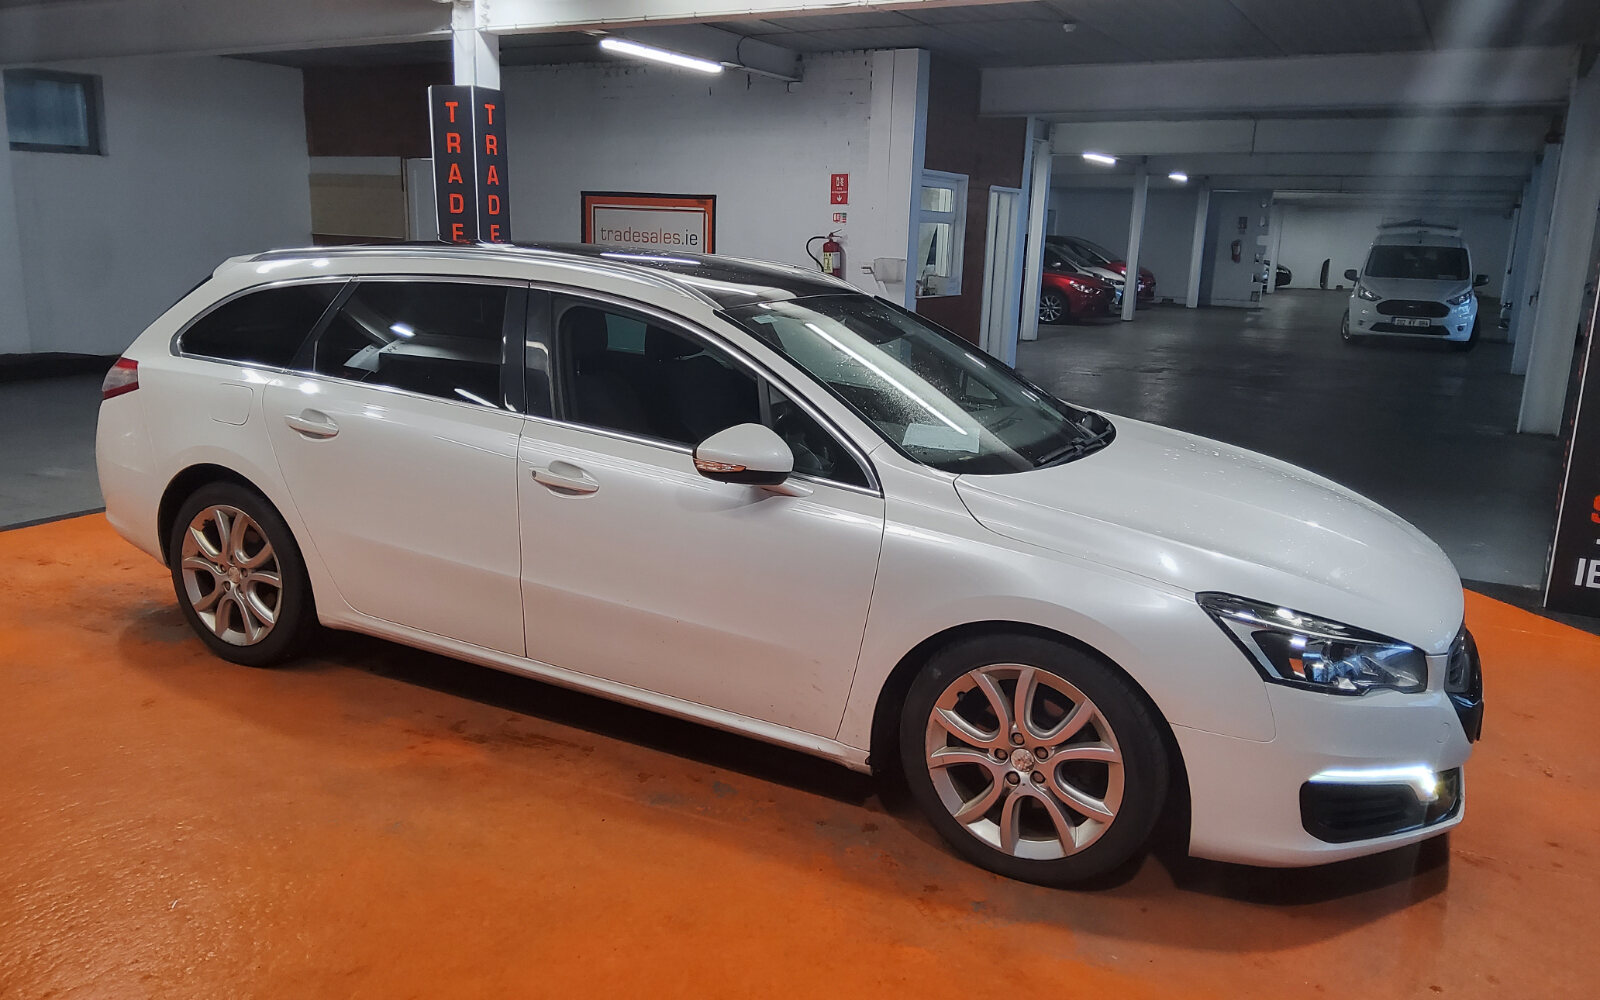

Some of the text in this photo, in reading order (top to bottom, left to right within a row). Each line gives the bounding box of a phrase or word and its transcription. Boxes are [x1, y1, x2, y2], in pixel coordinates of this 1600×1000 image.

[444, 100, 465, 242] TRADE
[484, 103, 501, 243] TRADE
[600, 226, 699, 246] tradesales.ie
